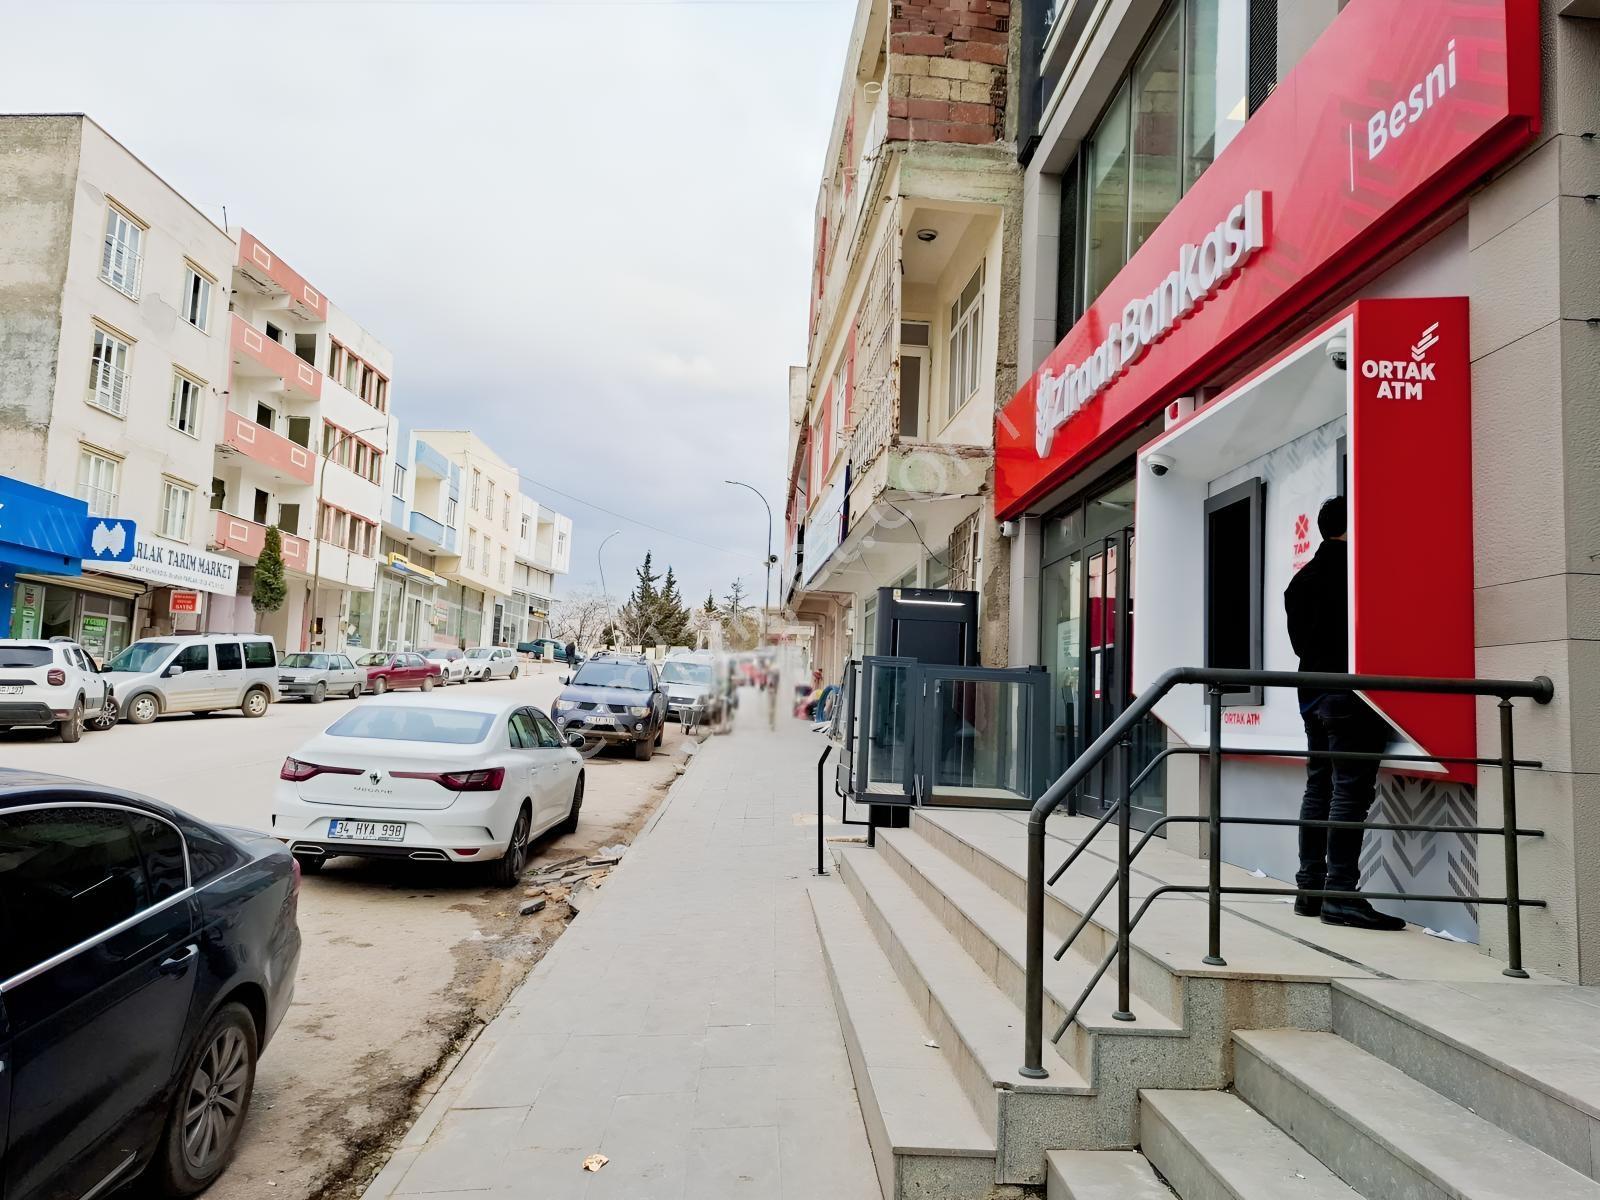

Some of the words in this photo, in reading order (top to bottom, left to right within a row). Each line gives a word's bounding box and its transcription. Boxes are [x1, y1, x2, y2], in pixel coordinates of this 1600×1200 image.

[1368, 38, 1456, 160] Besni
[1361, 359, 1436, 381] ORTAK
[1376, 380, 1423, 401] ATM
[168, 550, 196, 572] TARIM
[197, 557, 233, 580] MARKET
[1224, 712, 1245, 725] ORTAK
[1246, 712, 1261, 726] ATM
[337, 822, 350, 834] 34
[356, 823, 375, 835] HYA
